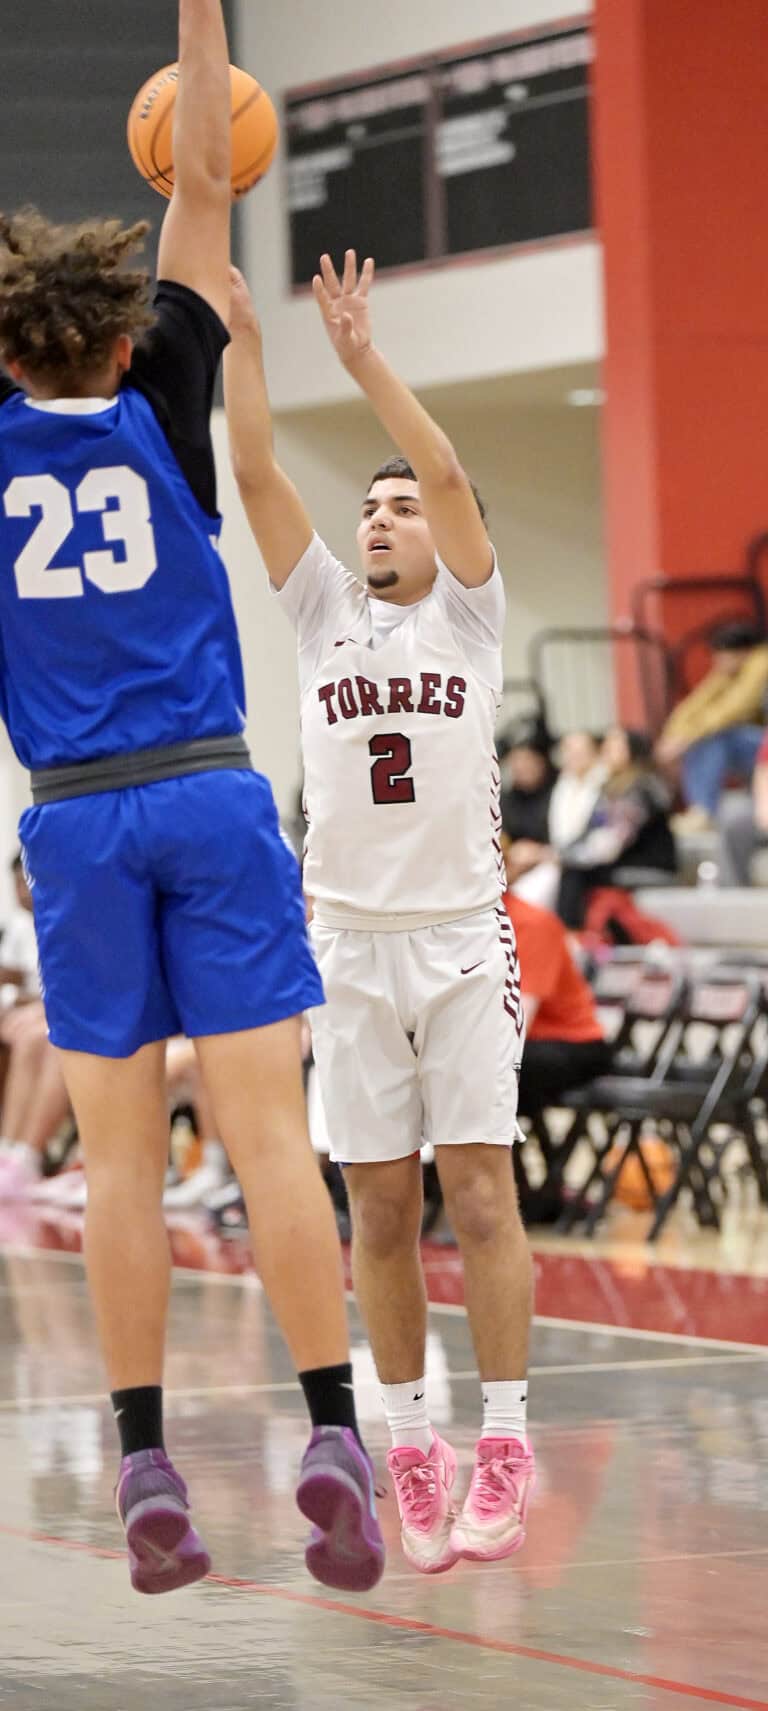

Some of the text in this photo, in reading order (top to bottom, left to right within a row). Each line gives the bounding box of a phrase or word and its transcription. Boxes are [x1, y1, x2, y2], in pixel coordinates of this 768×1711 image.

[3, 465, 158, 599] 23
[318, 672, 467, 725] TORRES
[368, 732, 416, 805] 2
